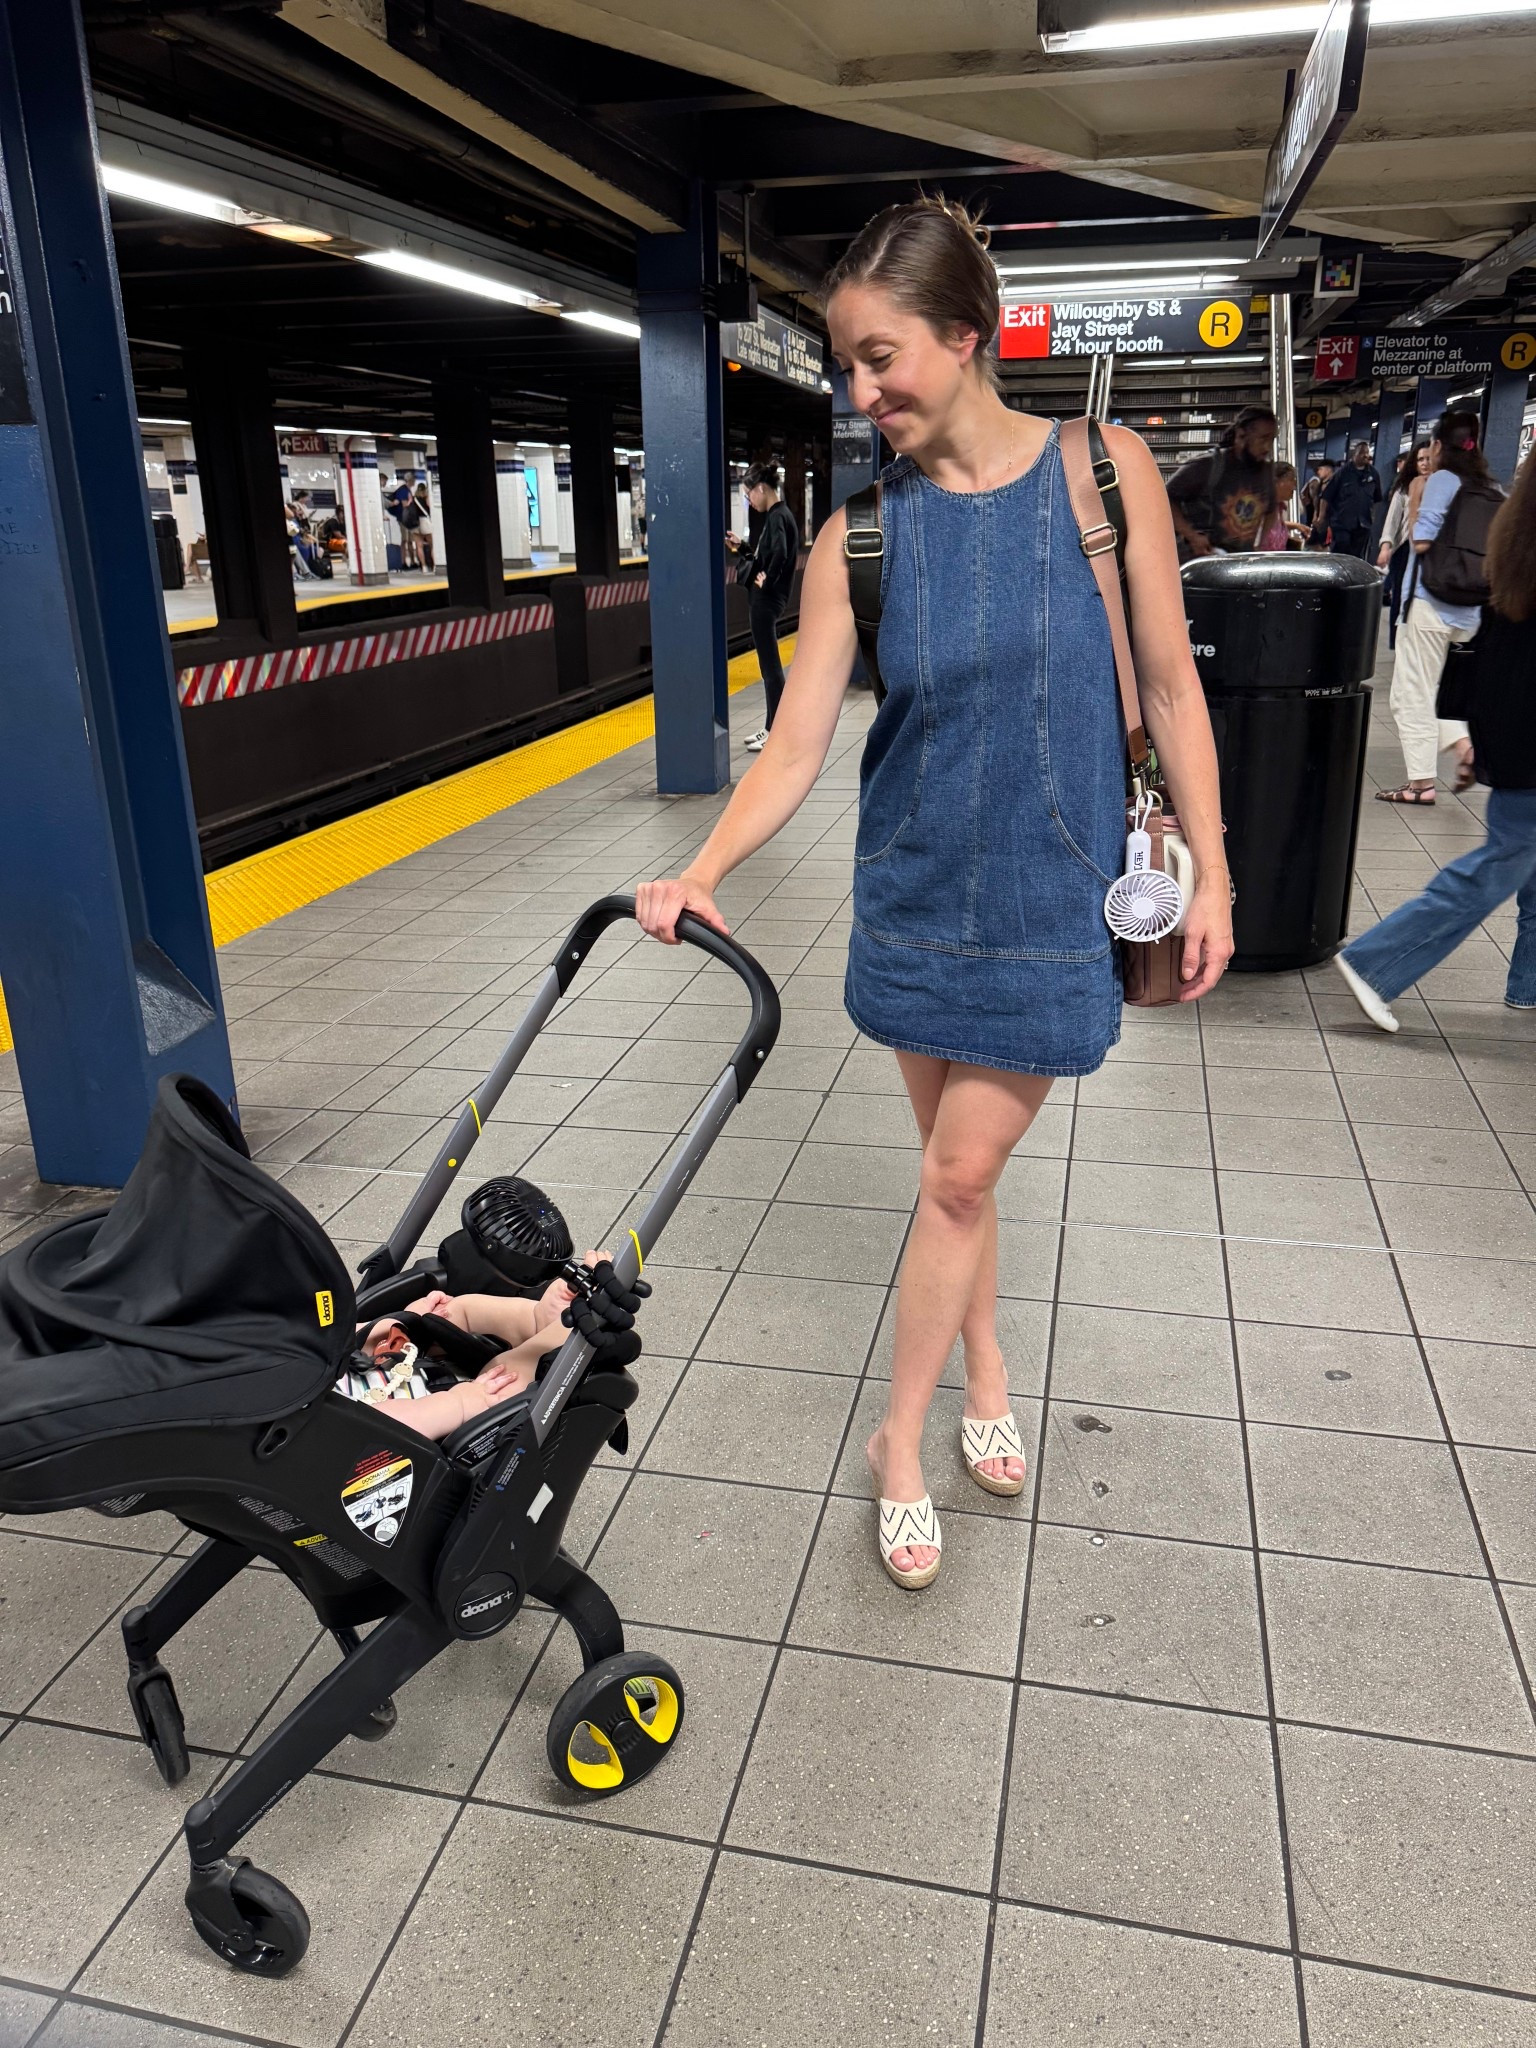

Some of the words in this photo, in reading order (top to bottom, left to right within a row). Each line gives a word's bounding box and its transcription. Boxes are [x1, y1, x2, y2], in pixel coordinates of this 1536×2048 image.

[1003, 305, 1046, 328] Exit
[1053, 300, 1143, 321] Willoughby
[1147, 300, 1165, 316] St
[1168, 299, 1182, 316] &
[1051, 322, 1080, 339] Jay
[1084, 321, 1134, 337] Street
[1210, 312, 1230, 336] R
[1051, 340, 1071, 355] 24
[1075, 338, 1112, 354] hour
[1116, 336, 1163, 352] booth
[1318, 337, 1354, 355] Exit
[1375, 336, 1429, 348] Elevator
[1434, 335, 1447, 346] to
[1373, 349, 1445, 362] Mezzanine
[1449, 347, 1462, 359] at
[1510, 341, 1526, 362] R
[1371, 363, 1415, 376] center
[1418, 361, 1432, 373] of
[1435, 361, 1492, 376] platform
[833, 421, 847, 431] Jay
[848, 421, 871, 429] Street
[833, 431, 872, 439] MetroTech
[291, 435, 320, 452] Exit
[322, 1294, 331, 1321] doona
[543, 1386, 566, 1420] ADVERTENCIA
[237, 1809, 263, 1833] Parenting
[261, 1795, 277, 1810] made
[275, 1779, 293, 1796] simple
